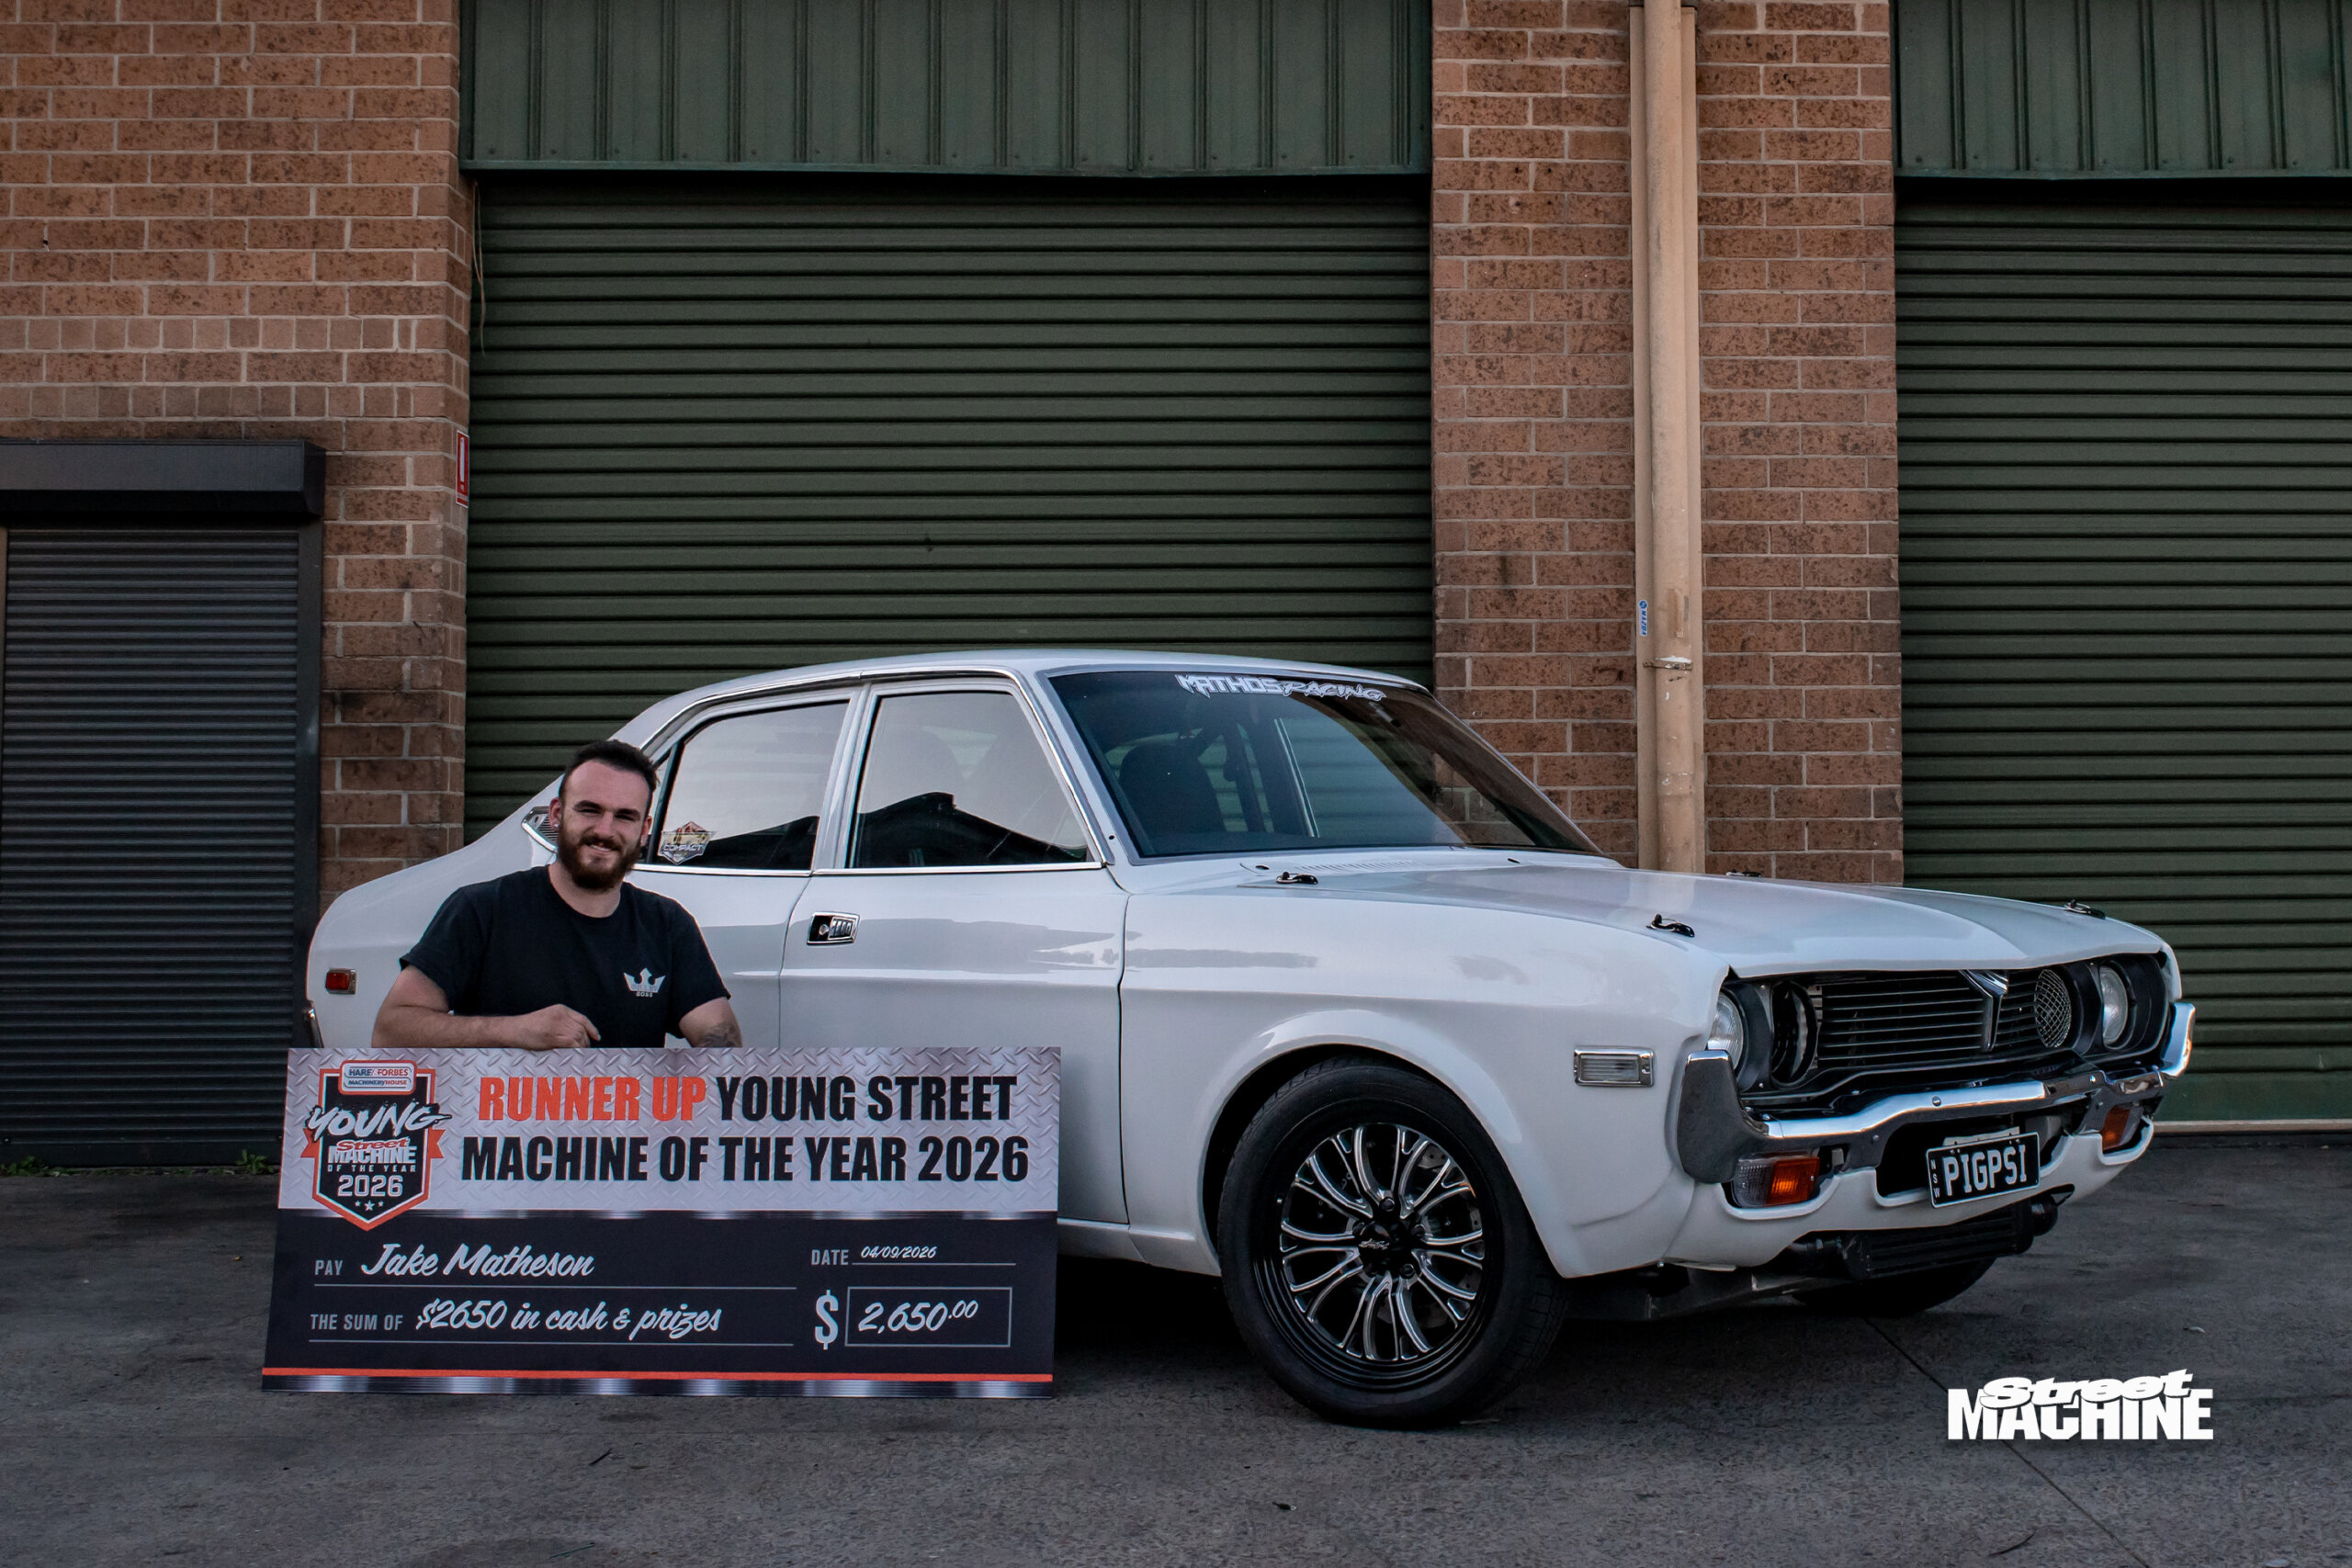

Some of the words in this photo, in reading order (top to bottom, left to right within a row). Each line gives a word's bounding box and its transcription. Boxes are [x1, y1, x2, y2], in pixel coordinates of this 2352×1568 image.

[1281, 681, 1386, 702] RACING
[478, 1077, 641, 1122] RUNNER
[651, 1076, 707, 1122] UP
[716, 1076, 856, 1122] YOUNG
[867, 1076, 1018, 1122] STREET
[308, 1101, 452, 1142] YOUNG
[328, 1145, 418, 1164] MACHINE
[336, 1138, 411, 1152] Street
[462, 1136, 649, 1181] MACHINE
[659, 1136, 709, 1182] OF
[718, 1136, 795, 1182] THE
[805, 1136, 908, 1182] YEAR
[918, 1135, 1030, 1183] 2026
[327, 1165, 343, 1173] OF
[352, 1165, 375, 1173] THE
[383, 1165, 416, 1173] YEAR
[1941, 1144, 2027, 1197] PIGPSI
[337, 1175, 403, 1197] 2026
[315, 1259, 344, 1276] PAY
[361, 1244, 439, 1277] Jake
[443, 1244, 595, 1277] Matheson
[811, 1249, 849, 1266] DATE
[861, 1246, 937, 1259] 04/09/2026
[311, 1314, 337, 1330] THE
[344, 1314, 378, 1330] SUM
[384, 1314, 403, 1330] OF
[415, 1298, 508, 1330] $2650
[511, 1303, 540, 1329] in
[545, 1302, 608, 1330] cash
[613, 1311, 631, 1329] &
[628, 1303, 723, 1341] prizes
[814, 1290, 839, 1350] $
